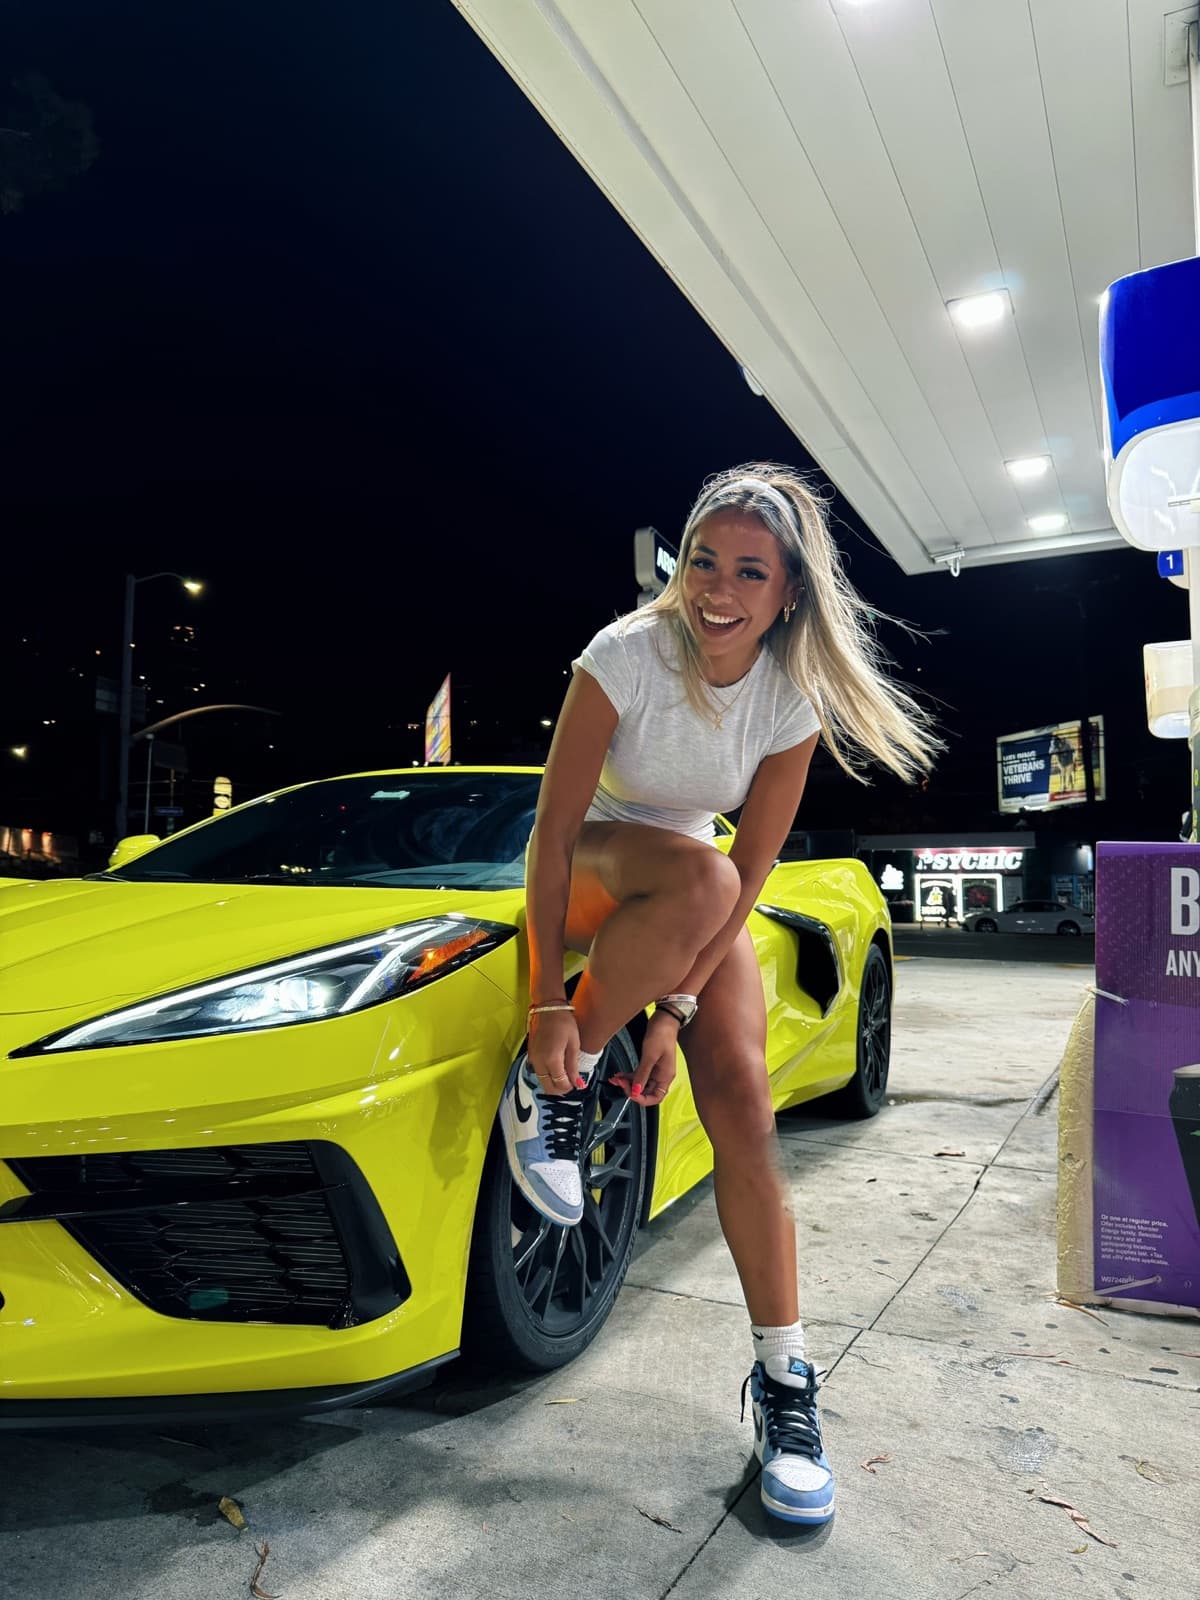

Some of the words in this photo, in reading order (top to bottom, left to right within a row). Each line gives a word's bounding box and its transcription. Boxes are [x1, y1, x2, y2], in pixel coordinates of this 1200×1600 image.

[1165, 554, 1174, 570] 1
[1003, 760, 1045, 775] VETERANS
[1003, 772, 1033, 785] THRIVE
[916, 851, 1023, 870] PSYCHIC
